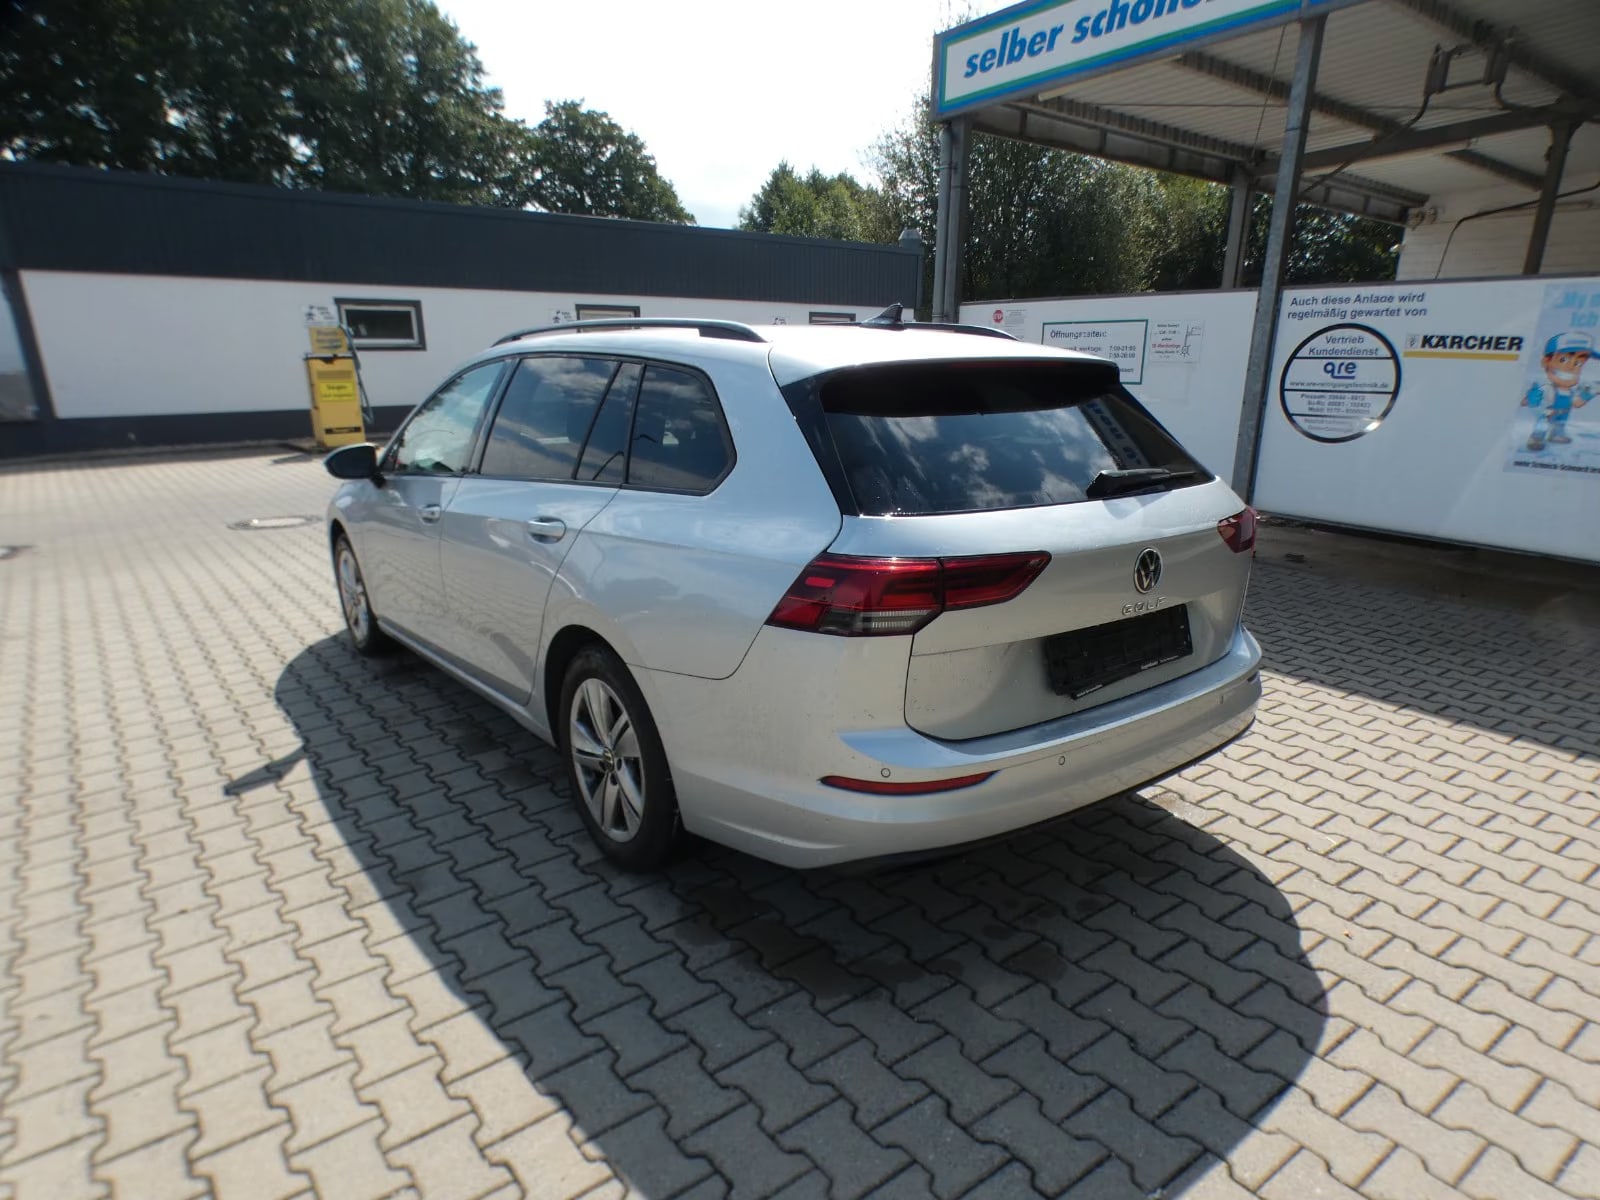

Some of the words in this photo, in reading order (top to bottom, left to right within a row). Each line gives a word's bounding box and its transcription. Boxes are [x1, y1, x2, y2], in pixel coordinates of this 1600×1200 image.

[965, 25, 1063, 78] selber
[1290, 295, 1319, 306] Auch
[1321, 294, 1350, 305] diese
[1353, 293, 1394, 305] Anlage
[1398, 292, 1425, 303] wird
[1288, 307, 1347, 320] regelmäßig
[1350, 307, 1400, 319] gewartet
[1405, 307, 1427, 317] von
[1326, 335, 1364, 344] Vertrieb
[1421, 334, 1523, 351] KÄRCHER
[1309, 347, 1379, 356] Kundendienst
[1122, 596, 1167, 615] GOLF
